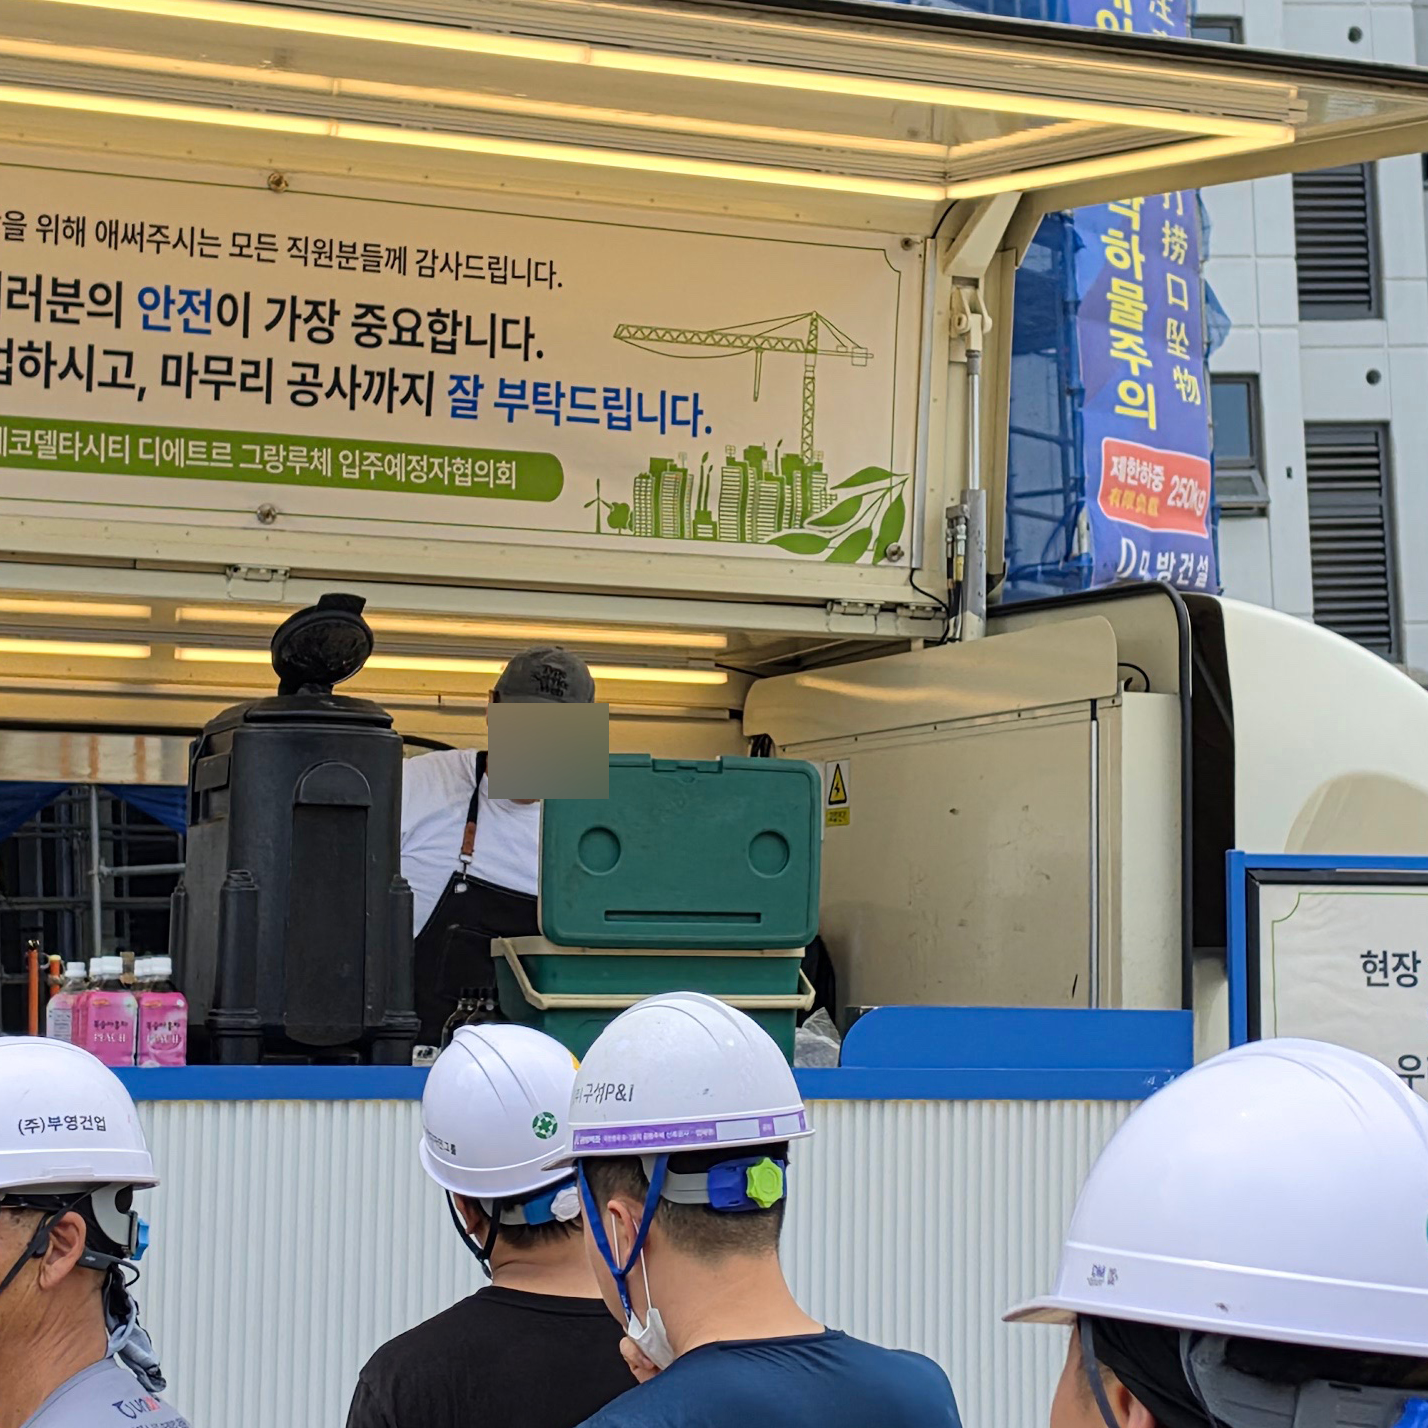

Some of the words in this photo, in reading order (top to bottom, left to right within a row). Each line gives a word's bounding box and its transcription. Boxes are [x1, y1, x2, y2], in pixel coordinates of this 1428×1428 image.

[35, 214, 86, 248] 위해
[95, 219, 222, 259] 애써주시는
[229, 232, 279, 264] 모든
[287, 236, 407, 276] 직원분들께
[415, 248, 563, 289] 감사드립니다.
[138, 285, 251, 339] 안전이
[265, 295, 340, 346] 가장
[351, 302, 544, 362] 중요합니다.
[160, 352, 272, 406] 마무리
[287, 359, 435, 417] 공사까지
[447, 374, 484, 419] 잘
[493, 378, 713, 439] 부탁드립니다.
[139, 436, 234, 471] 디에트르
[239, 443, 332, 478] 그랑루체
[339, 449, 518, 491] 입주예정자협의회
[1111, 456, 1165, 492] 제한하중
[1167, 475, 1207, 517] 250kg
[1360, 950, 1420, 989] 현장
[18, 1115, 106, 1136] (주)부영건업
